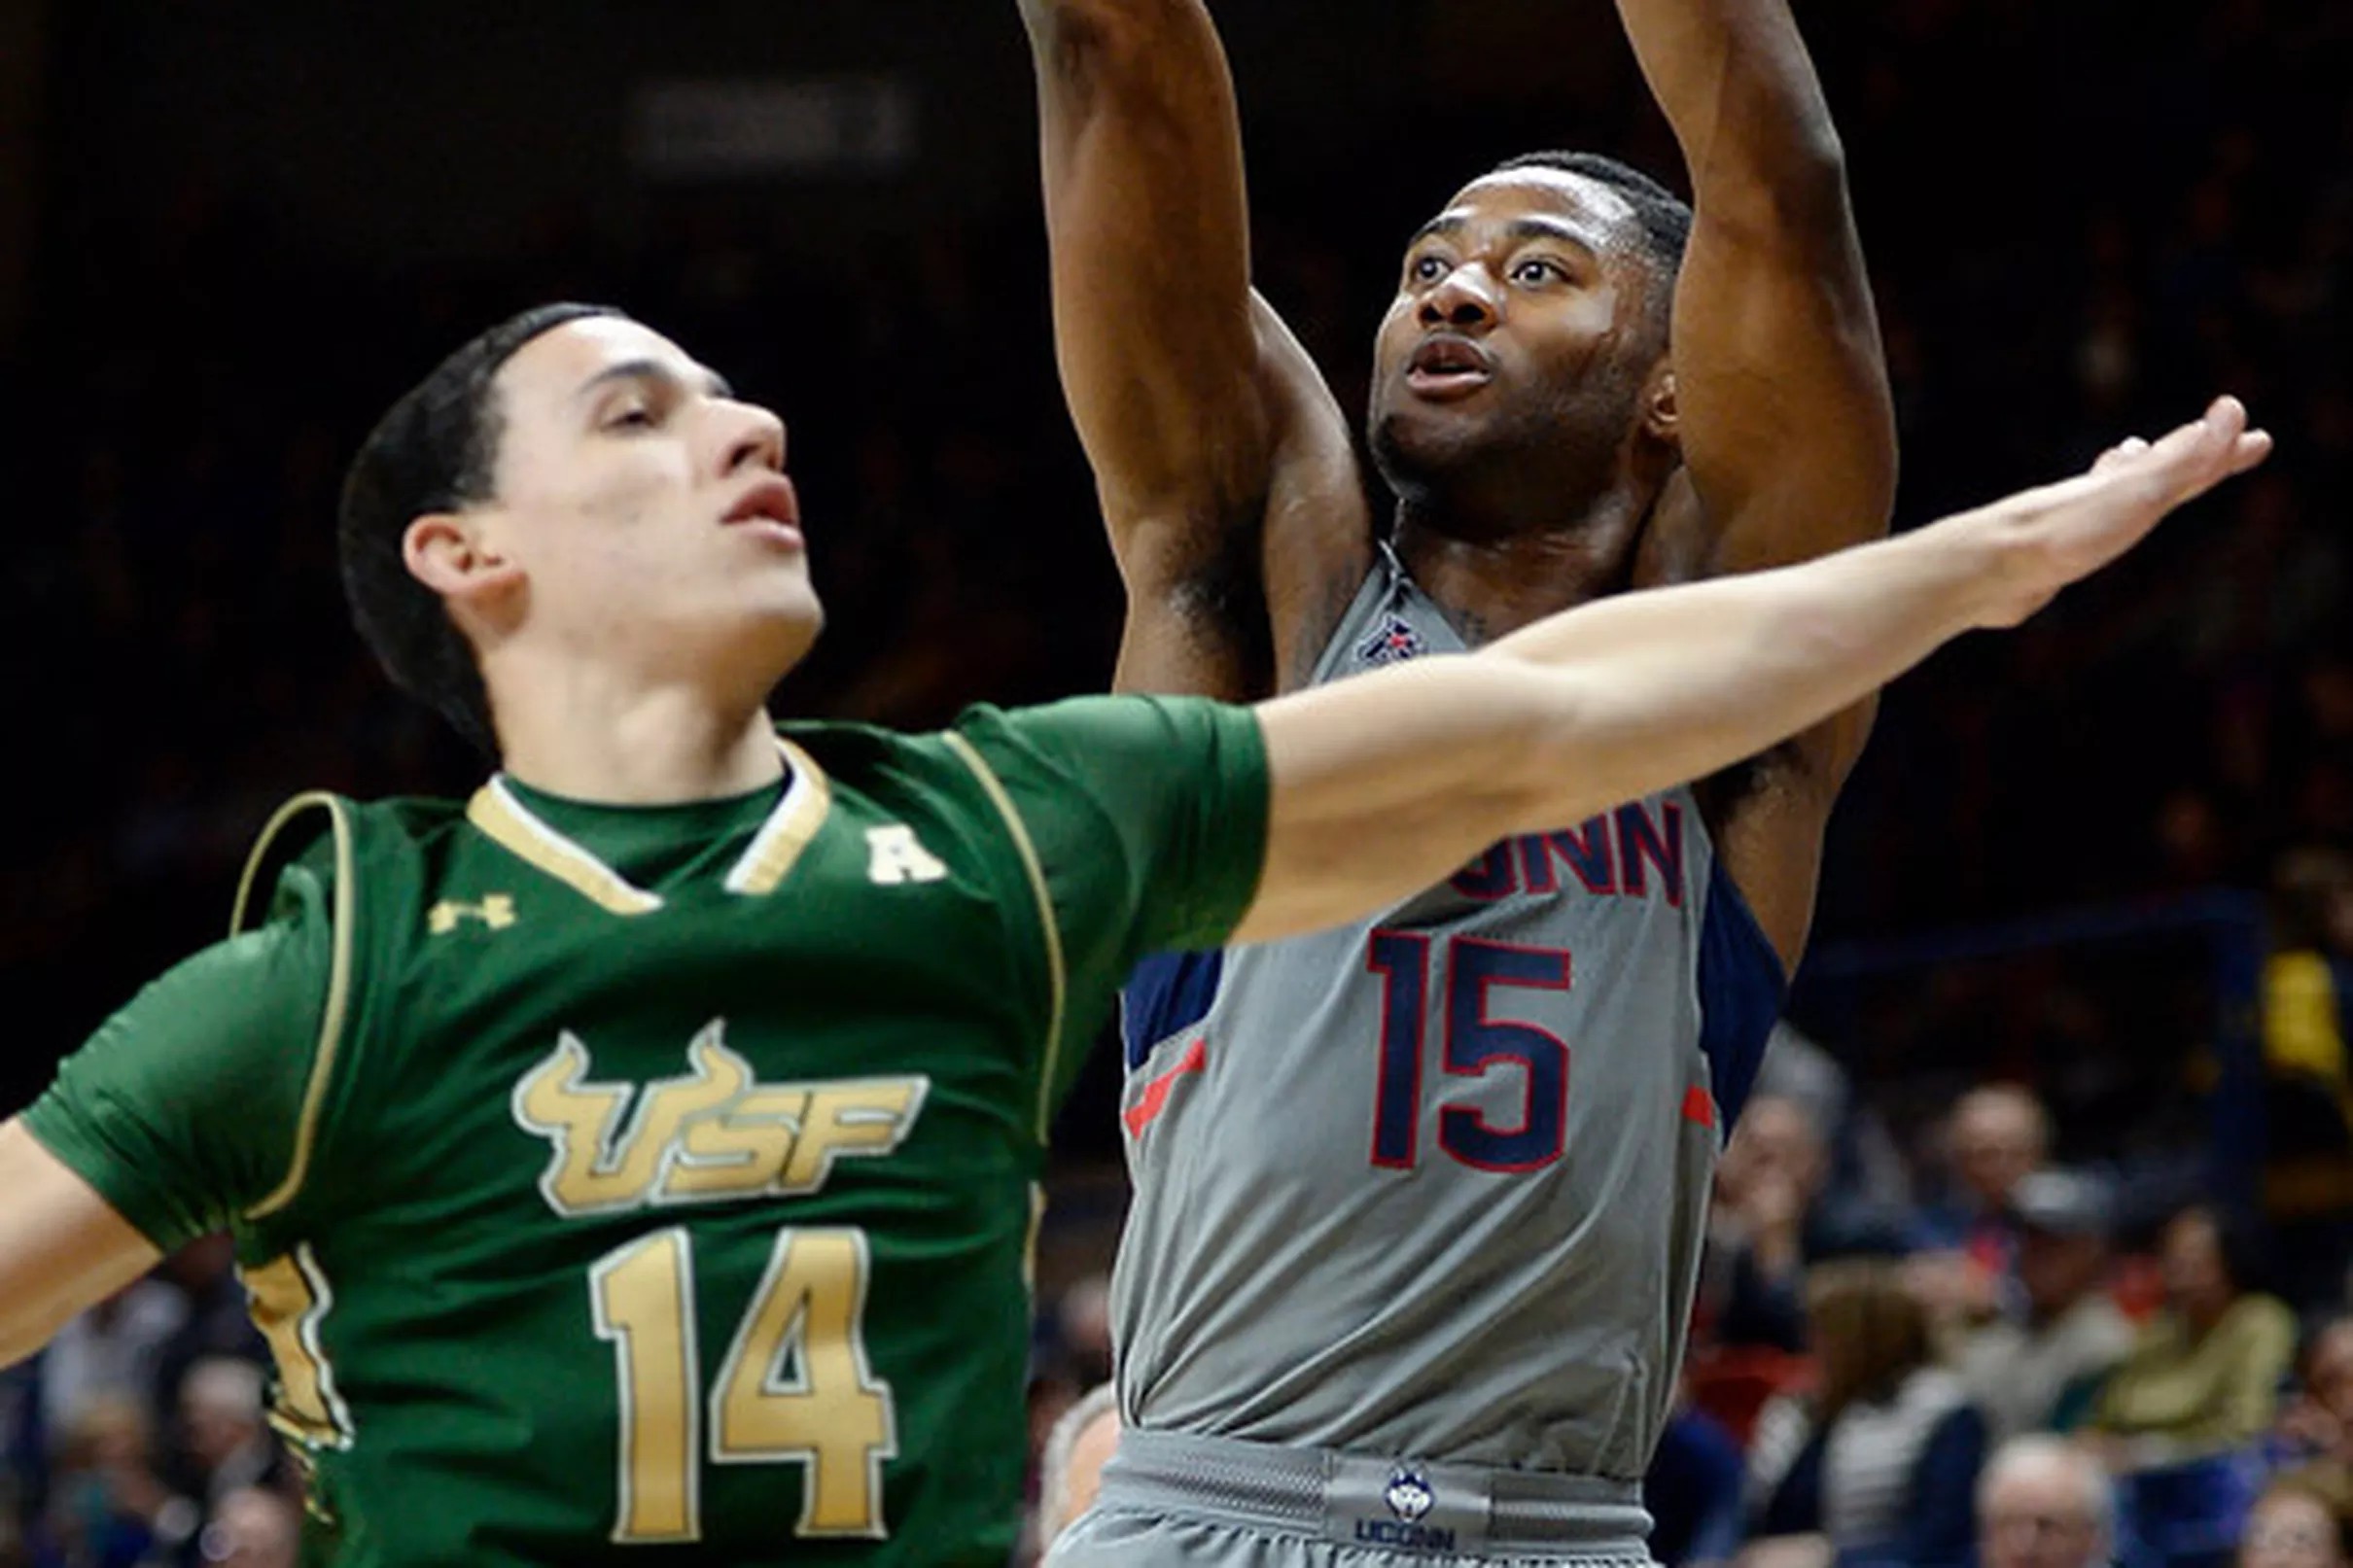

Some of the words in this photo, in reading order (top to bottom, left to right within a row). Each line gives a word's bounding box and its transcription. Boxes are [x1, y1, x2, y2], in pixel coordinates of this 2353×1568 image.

[511, 1018, 931, 1217] USF
[1366, 927, 1571, 1173] 15
[589, 1225, 898, 1542] 14
[1354, 1516, 1457, 1551] UCONN
